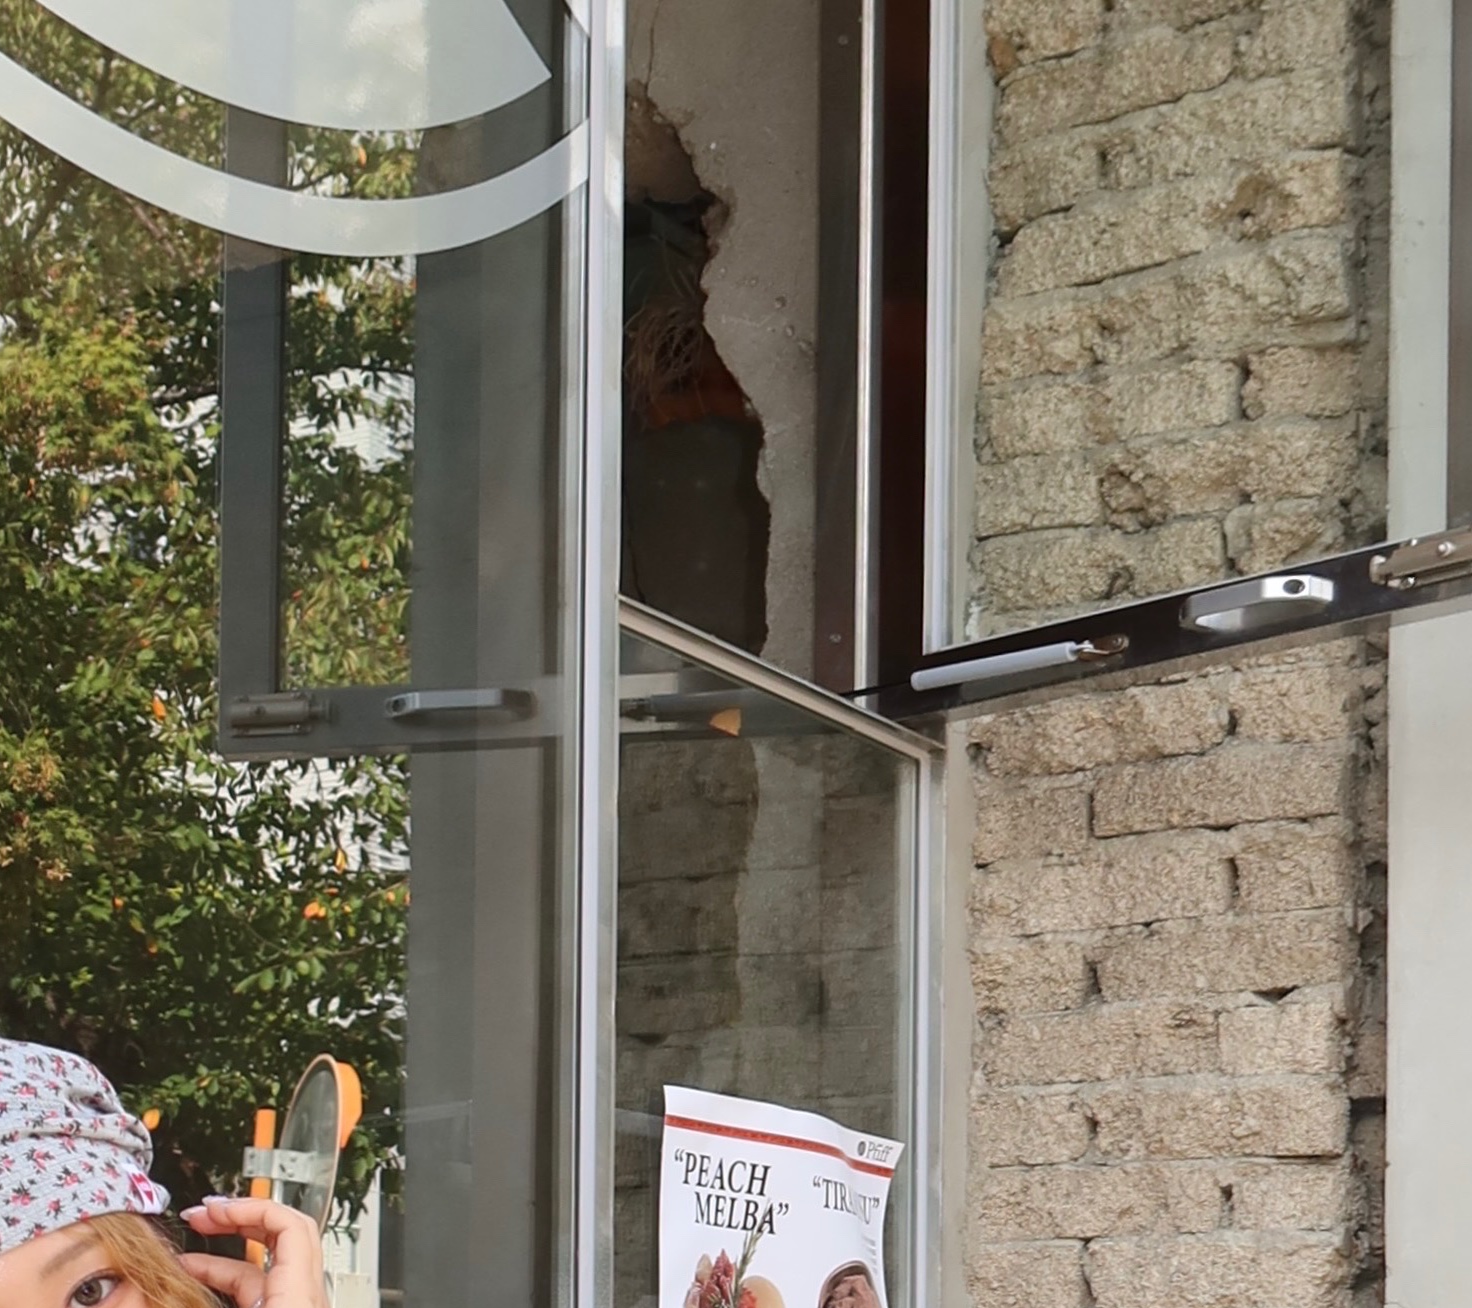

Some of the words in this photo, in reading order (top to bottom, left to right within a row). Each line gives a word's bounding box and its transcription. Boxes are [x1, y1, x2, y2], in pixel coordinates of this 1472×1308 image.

[674, 1148, 772, 1197] “PEACH
[866, 1140, 894, 1163] Pfiff
[694, 1191, 790, 1235] MELBA”
